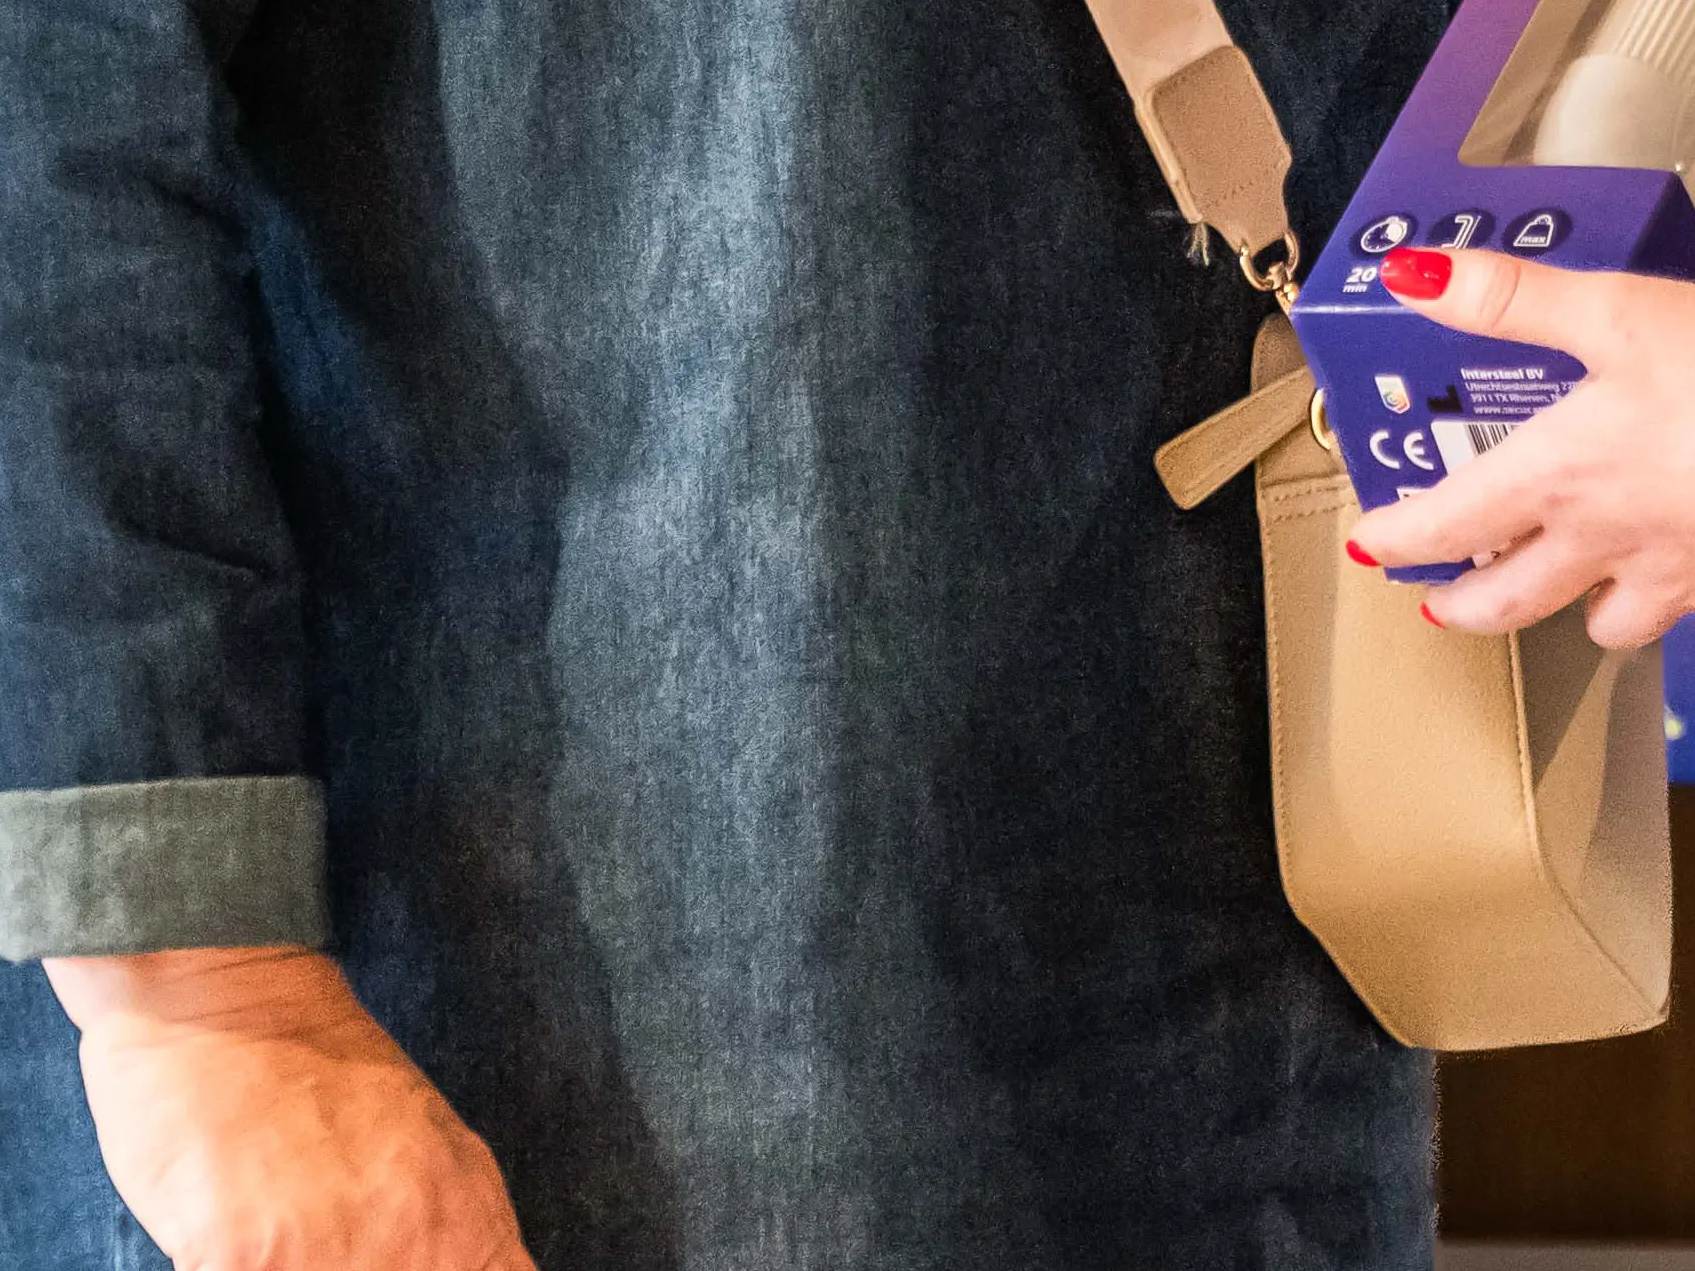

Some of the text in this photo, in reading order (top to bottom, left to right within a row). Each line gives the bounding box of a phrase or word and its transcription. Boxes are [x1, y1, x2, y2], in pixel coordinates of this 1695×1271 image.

[1519, 236, 1546, 244] max
[1346, 267, 1378, 283] 20
[1343, 283, 1368, 293] min
[1369, 430, 1434, 470] CE
